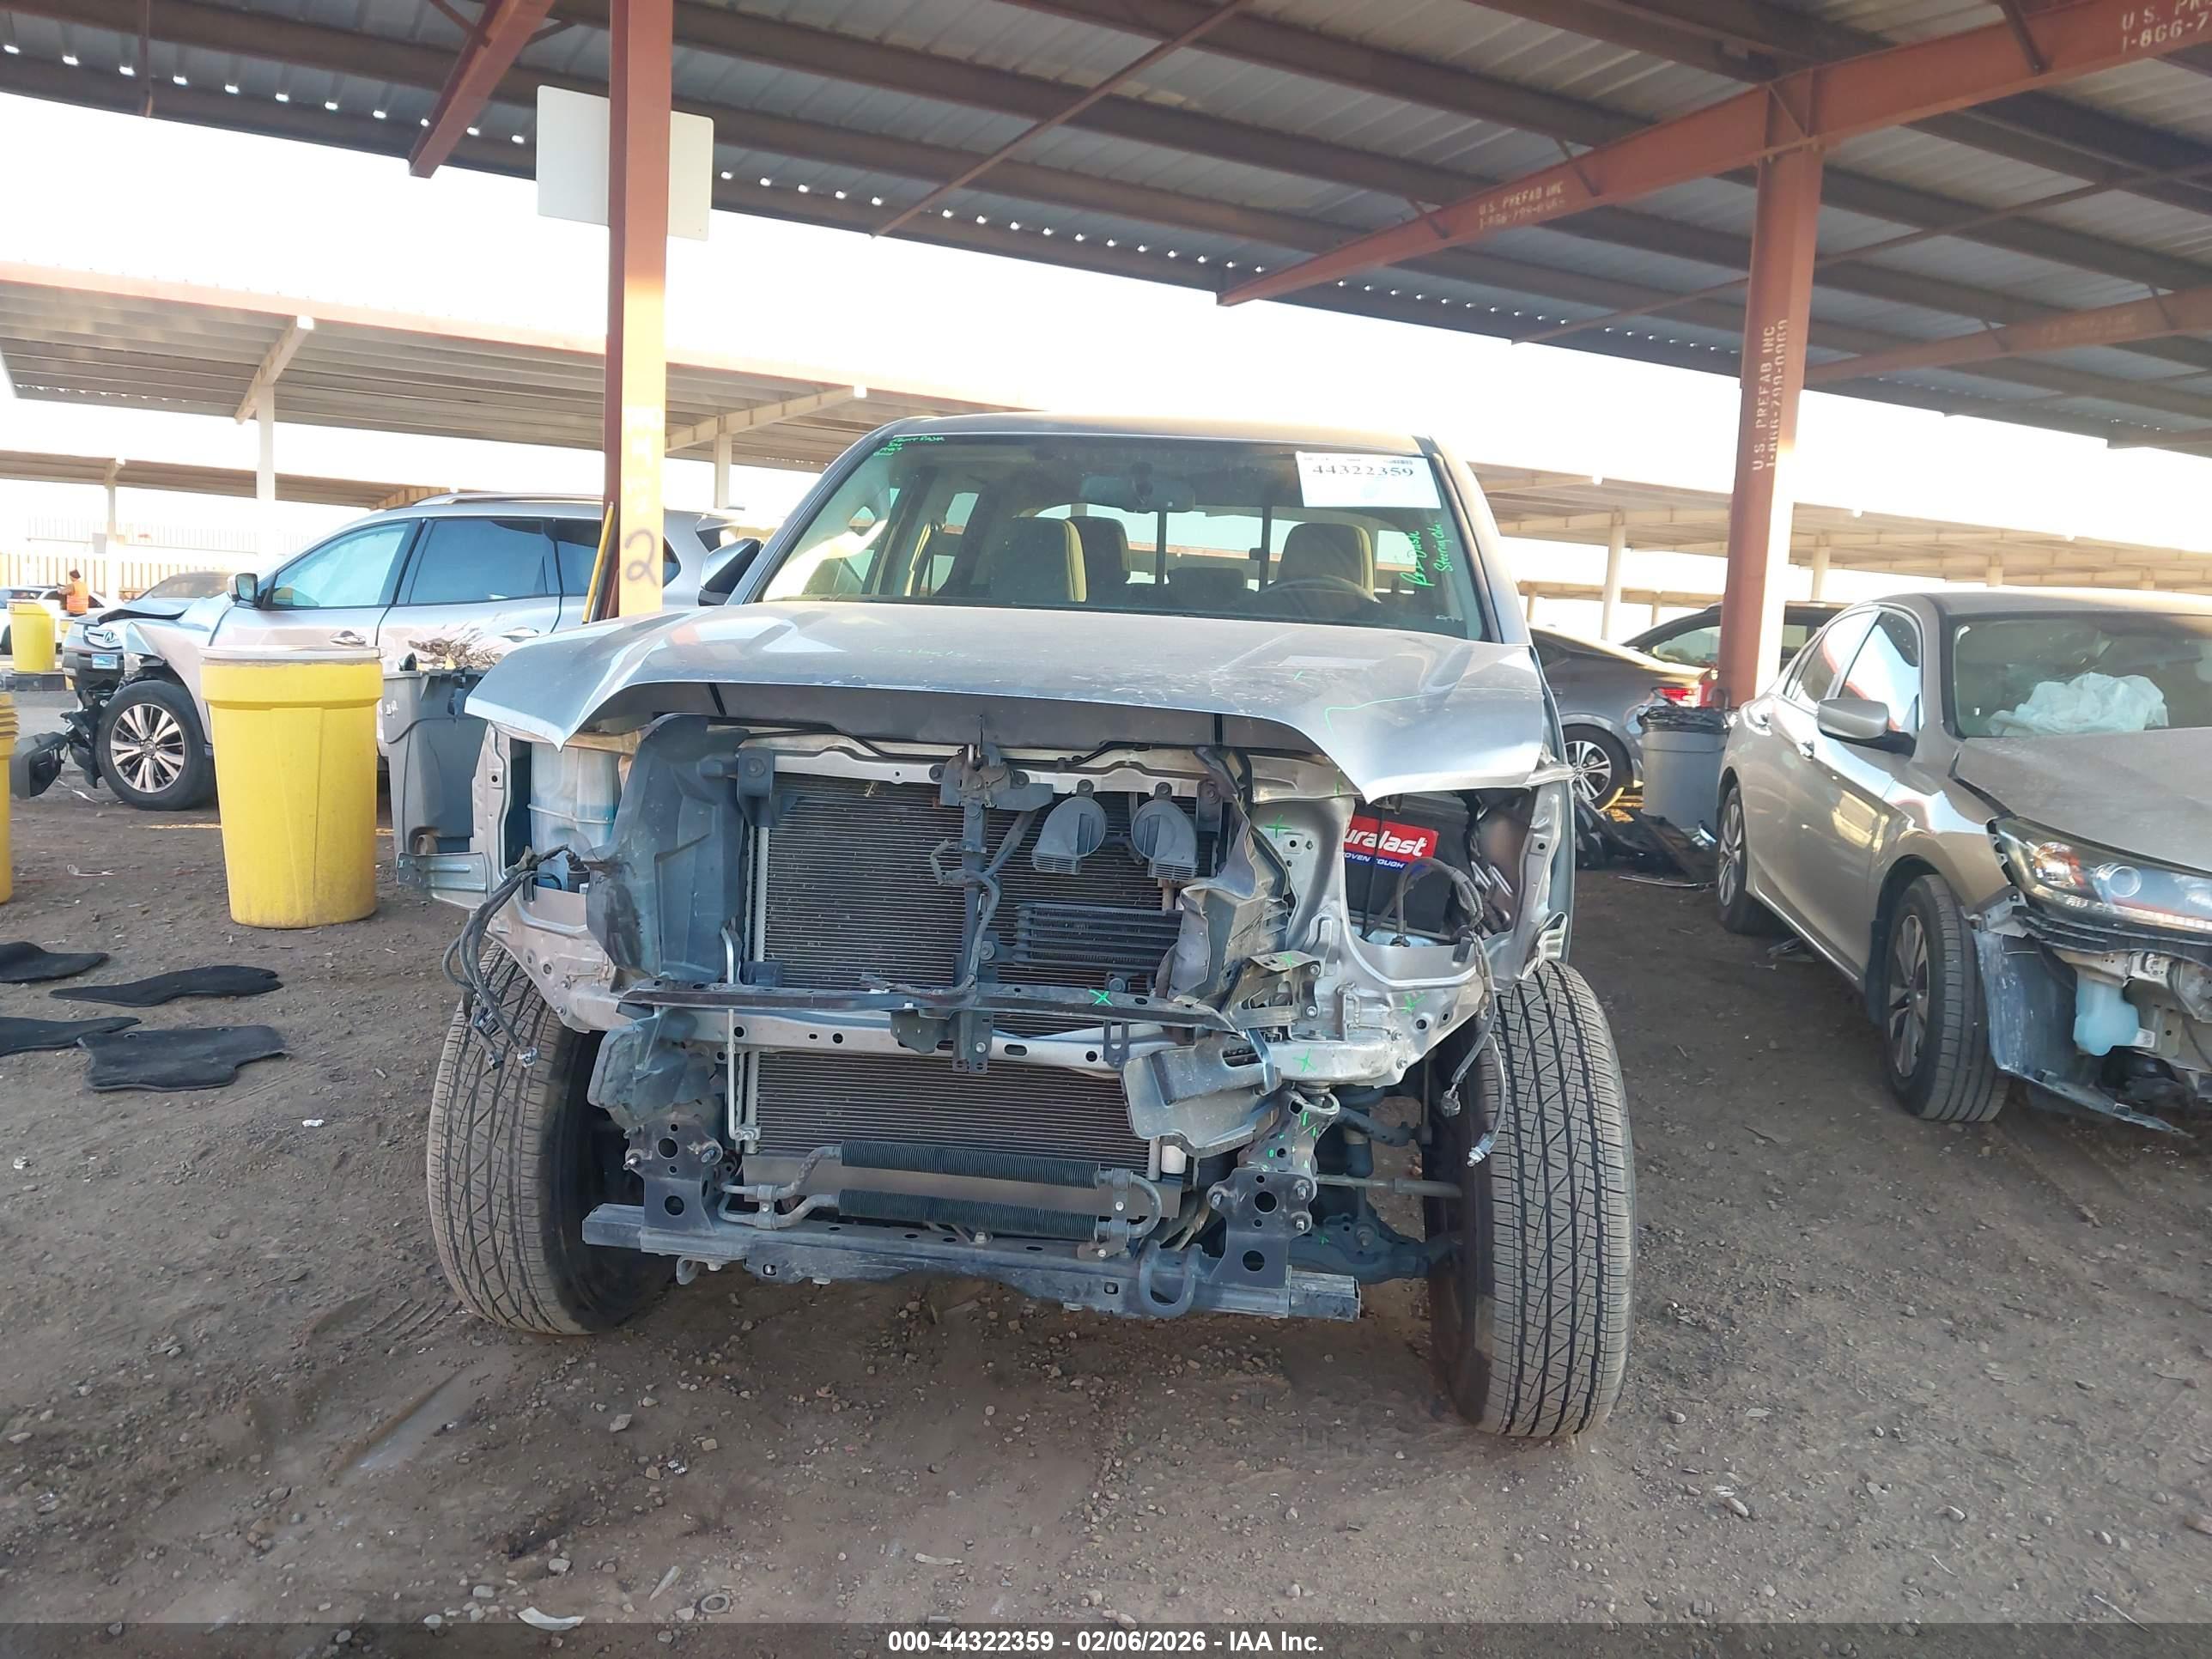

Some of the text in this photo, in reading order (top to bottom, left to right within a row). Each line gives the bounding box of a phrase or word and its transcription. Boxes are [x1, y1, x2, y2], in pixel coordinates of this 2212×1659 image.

[1762, 325, 1776, 354] INC
[1755, 362, 1773, 428] PREFAB
[1312, 465, 1414, 477] 44322359
[1344, 829, 1428, 857] uralast
[1341, 851, 1406, 869] OVEN OUGH
